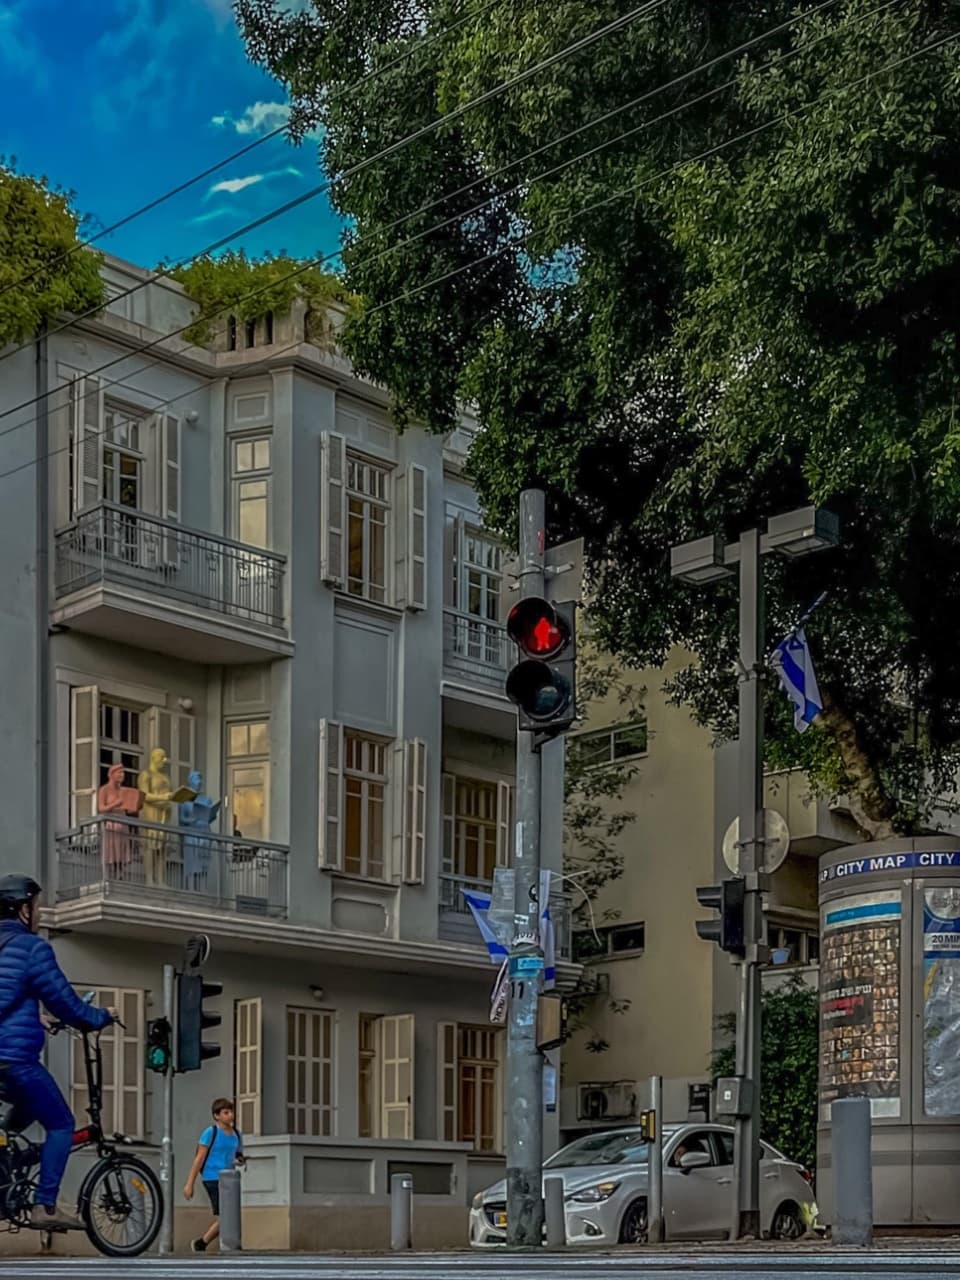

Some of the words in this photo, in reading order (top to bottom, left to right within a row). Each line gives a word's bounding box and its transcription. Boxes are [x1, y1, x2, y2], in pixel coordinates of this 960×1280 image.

[836, 860, 865, 877] CITY
[869, 855, 906, 870] MAP
[920, 853, 954, 865] CITY
